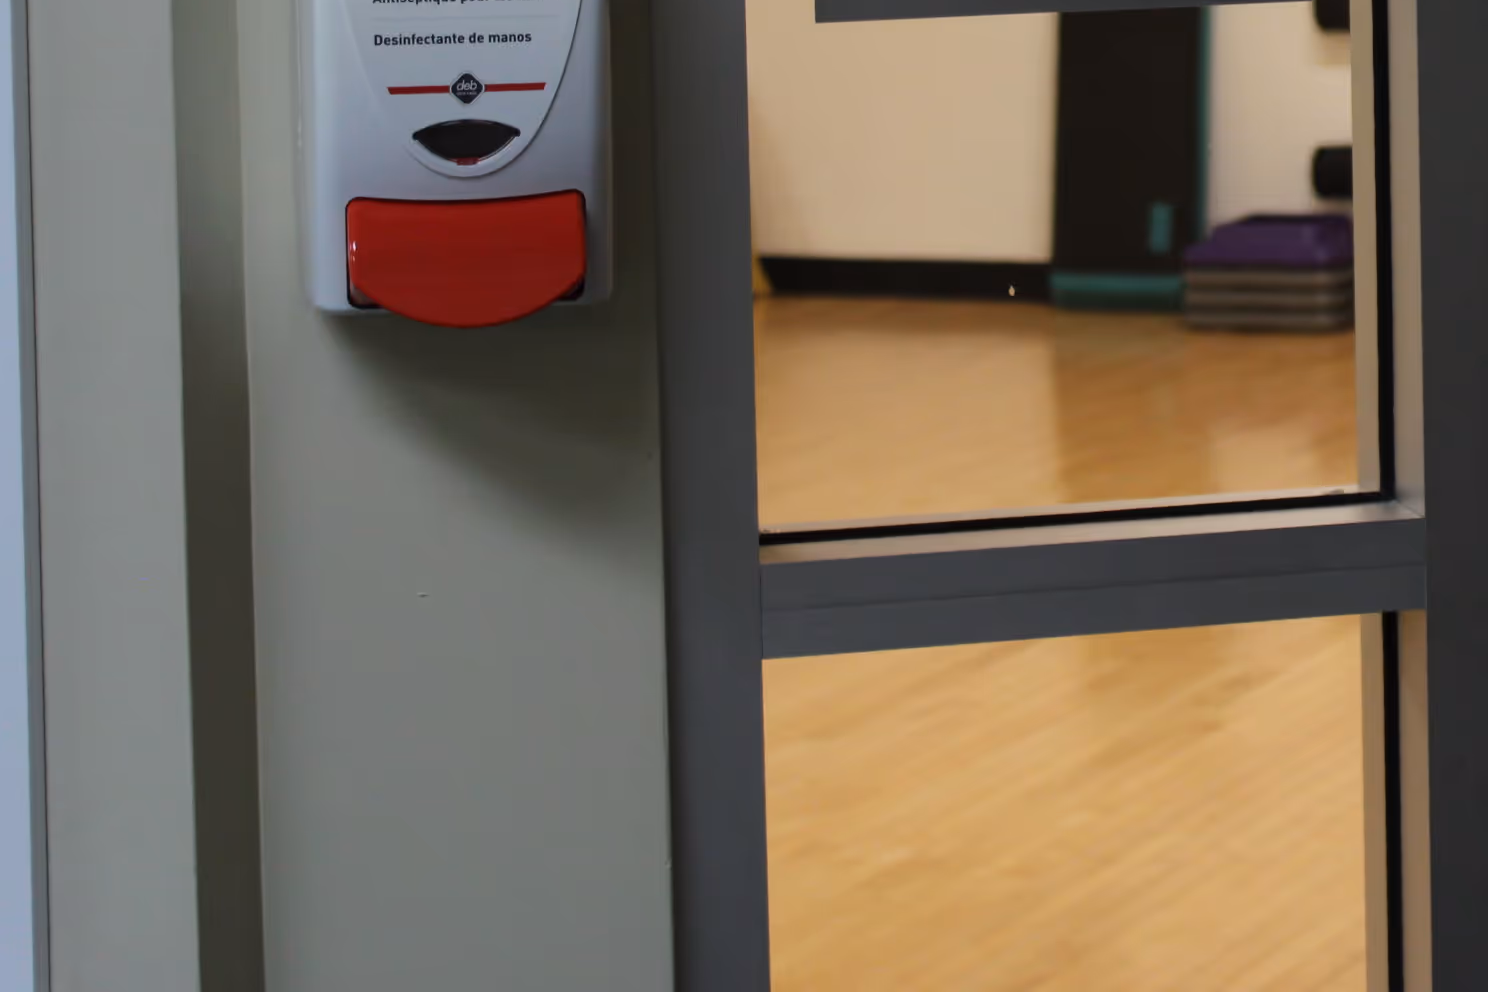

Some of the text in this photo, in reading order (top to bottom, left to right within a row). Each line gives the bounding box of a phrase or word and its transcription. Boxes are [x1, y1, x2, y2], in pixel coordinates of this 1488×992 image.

[374, 32, 532, 47] Desinfectante de manos
[456, 79, 478, 91] deb
